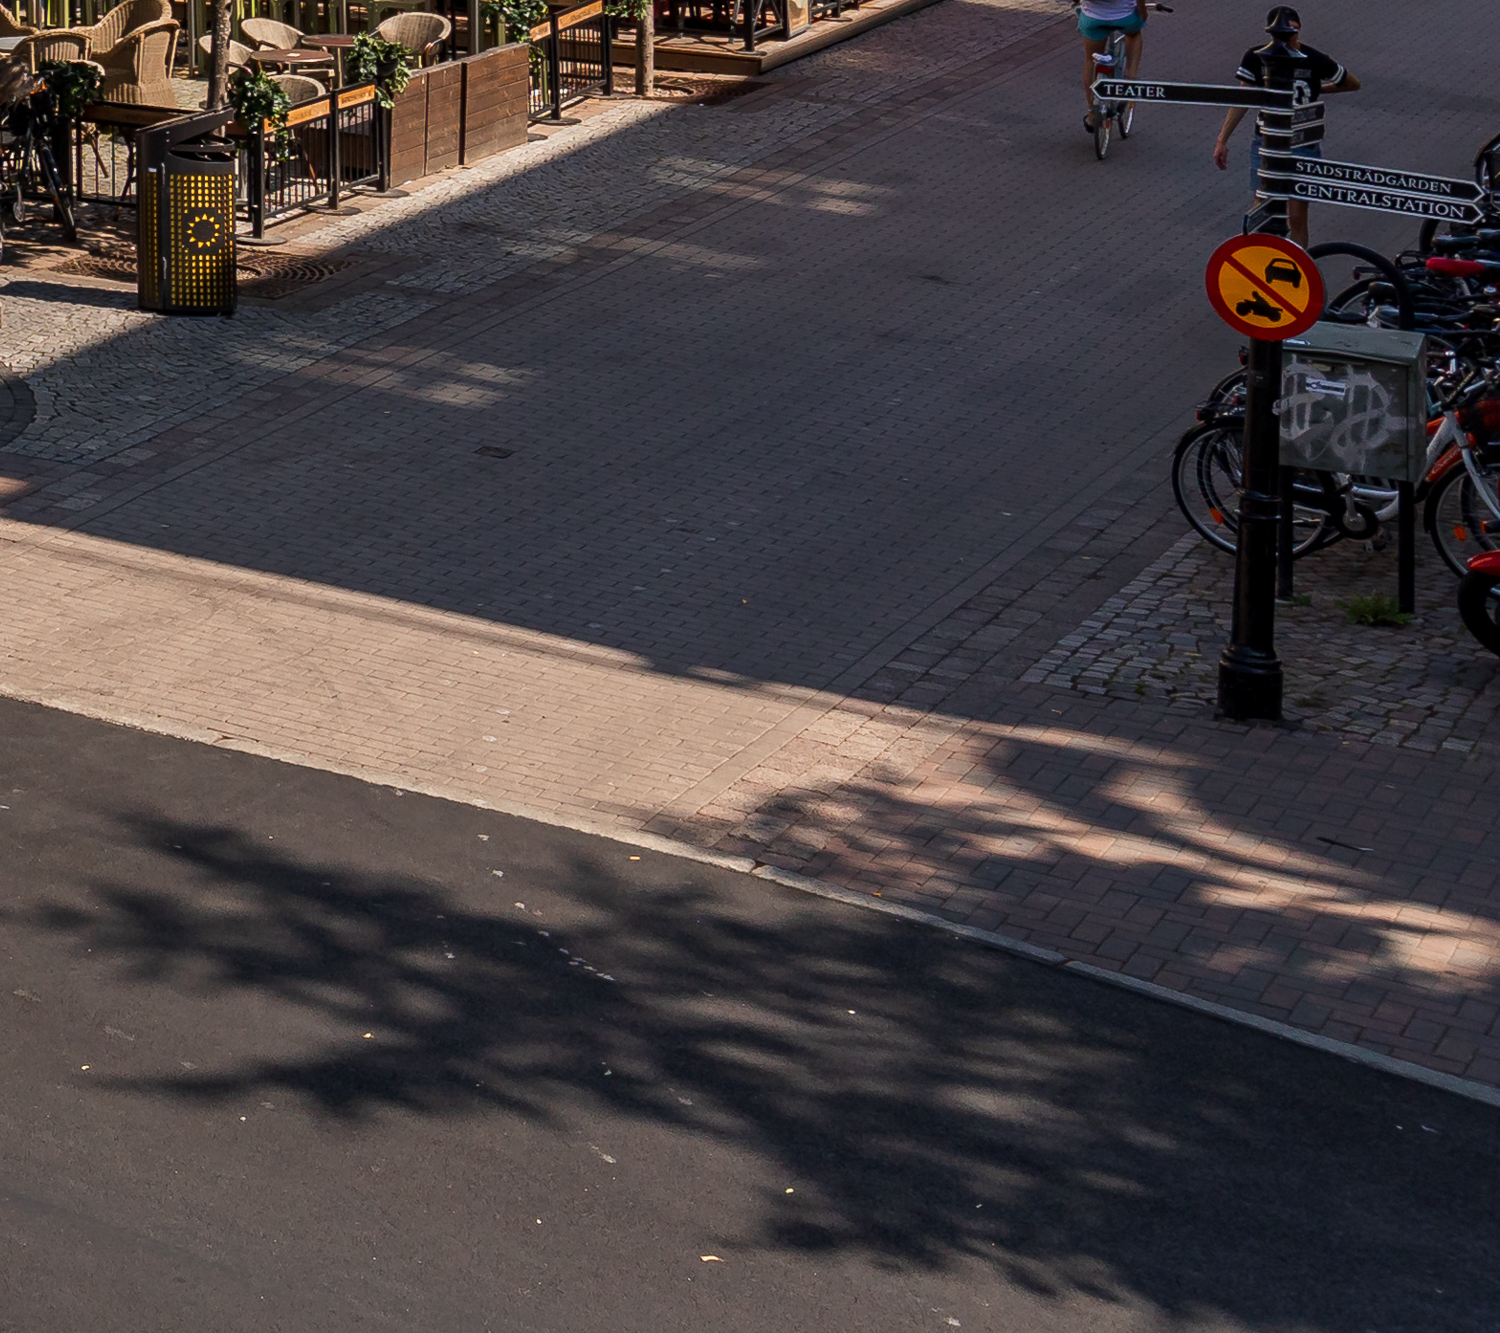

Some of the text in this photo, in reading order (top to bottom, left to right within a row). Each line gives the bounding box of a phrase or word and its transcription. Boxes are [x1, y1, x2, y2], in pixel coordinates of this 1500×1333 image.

[1103, 84, 1166, 98] TEATER
[1296, 161, 1451, 193] STADSTRÄDGÅRDEN
[1294, 183, 1466, 218] CENTRALSTATION
